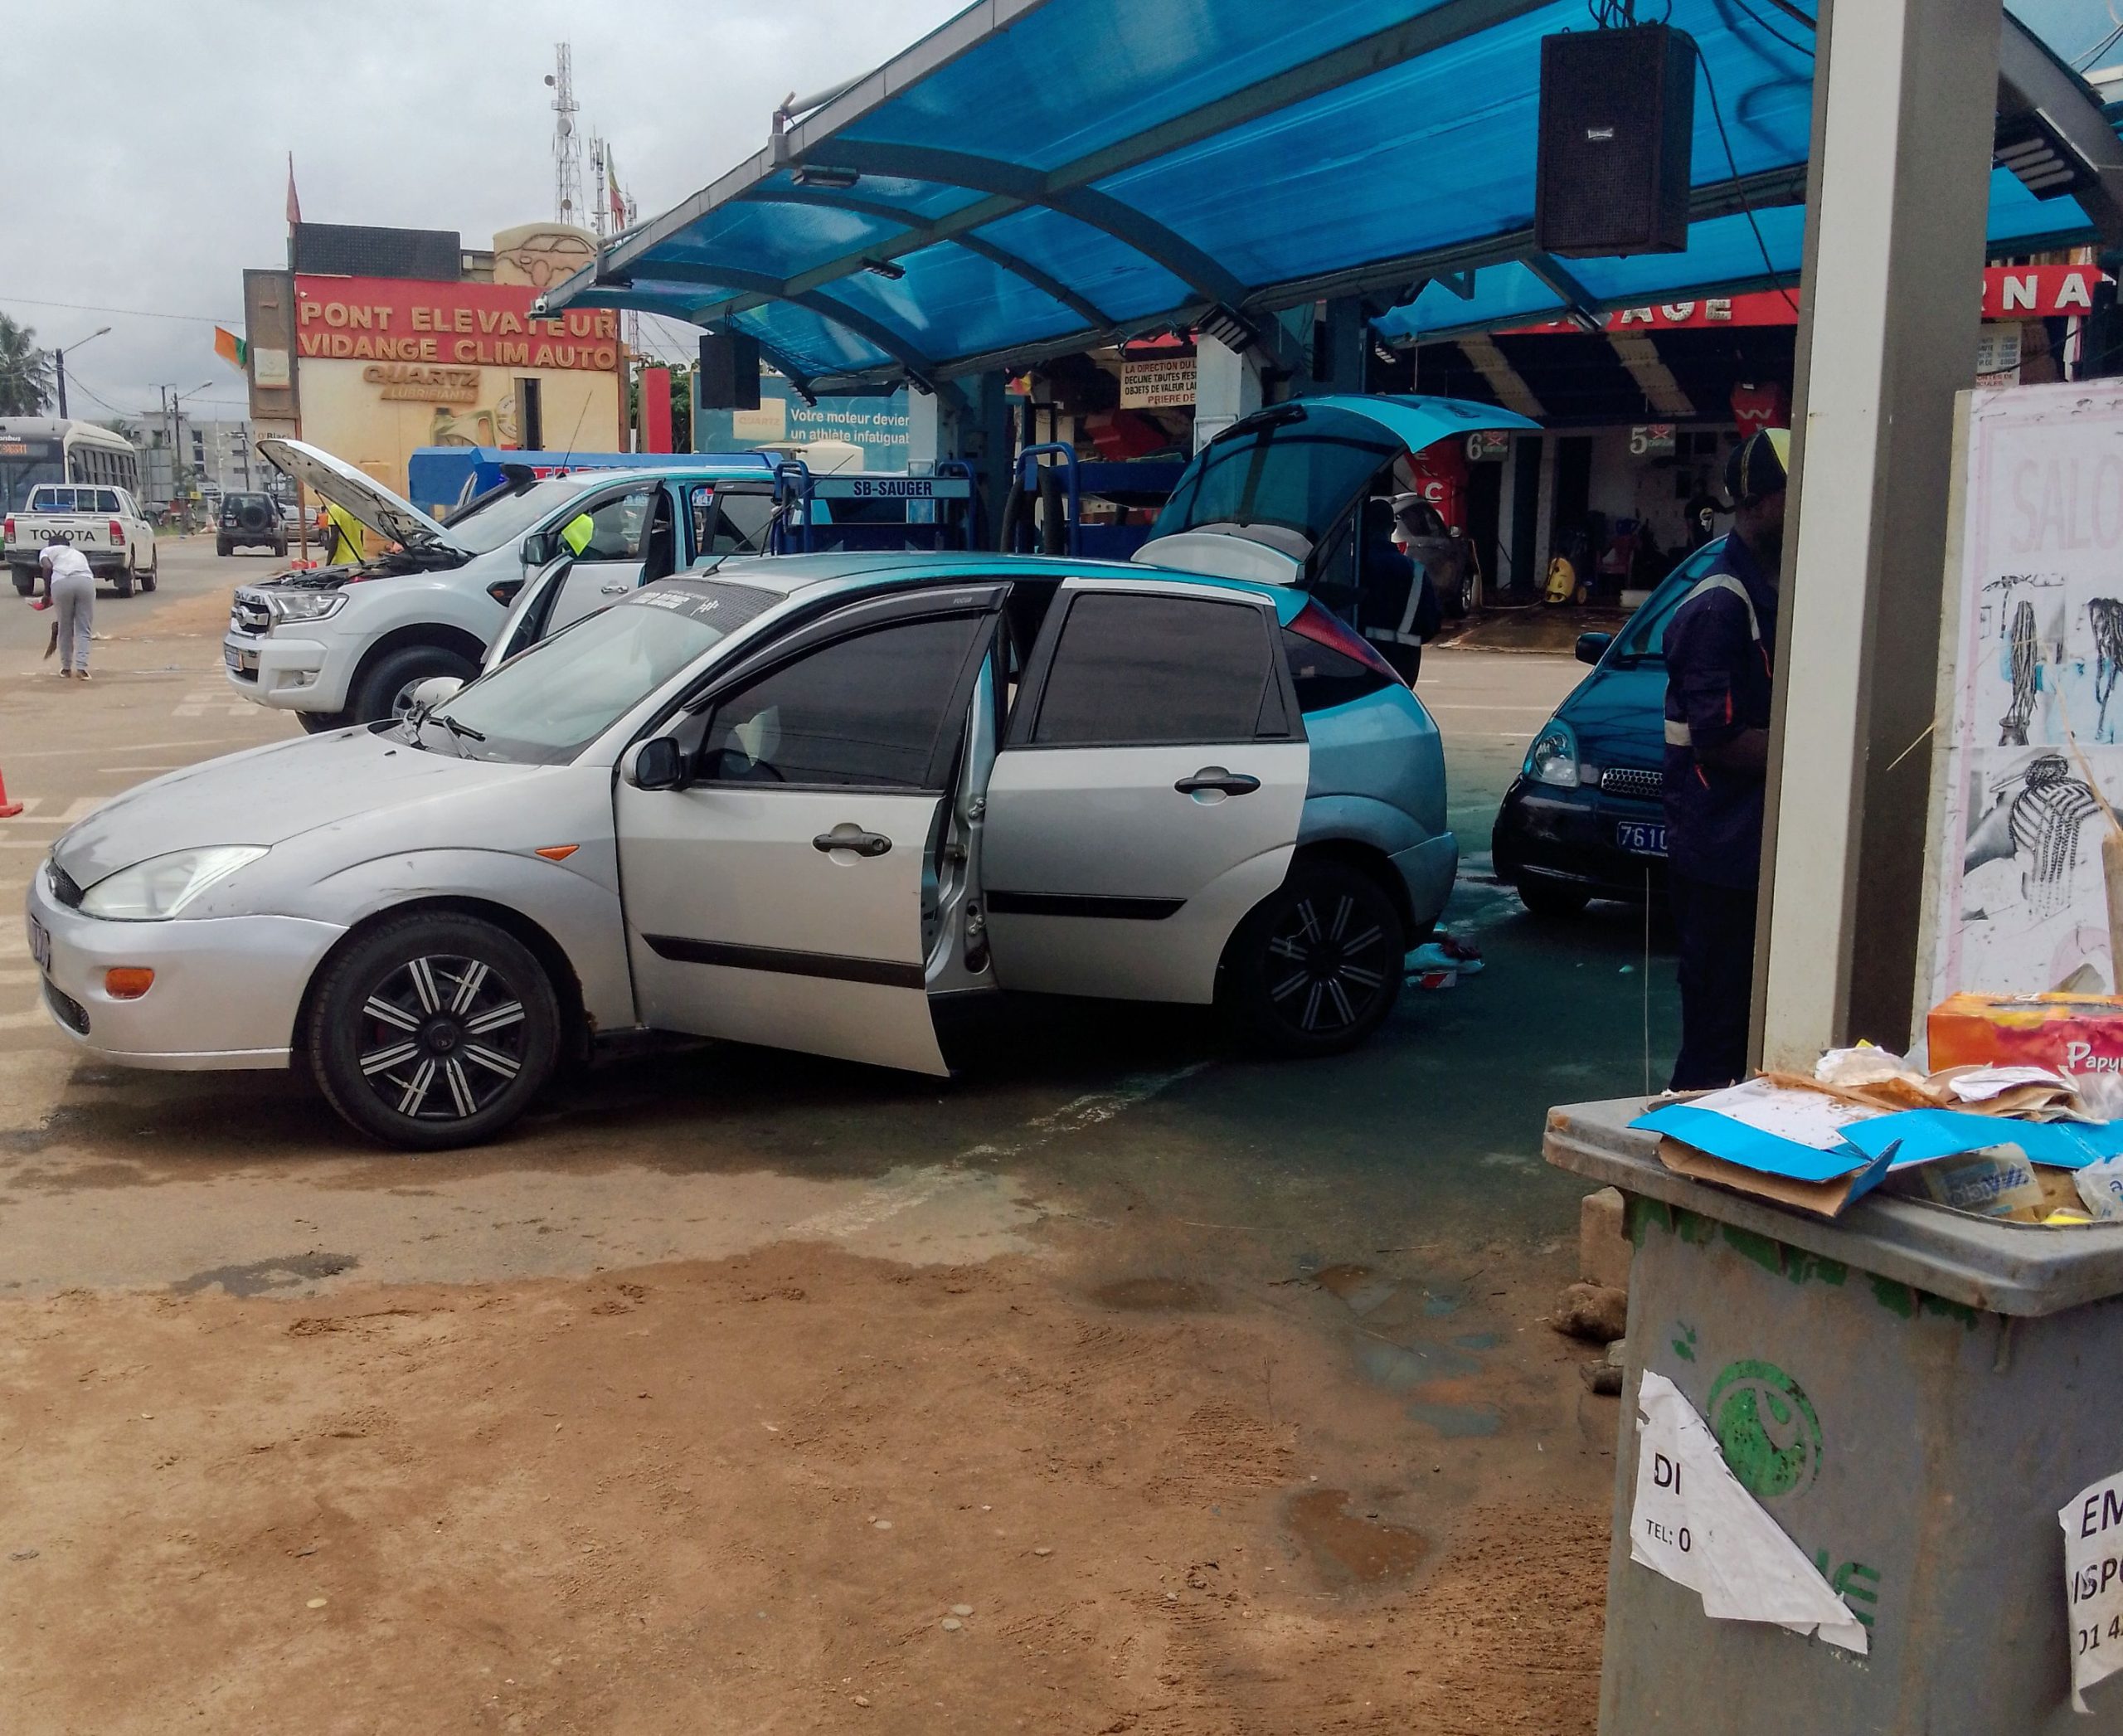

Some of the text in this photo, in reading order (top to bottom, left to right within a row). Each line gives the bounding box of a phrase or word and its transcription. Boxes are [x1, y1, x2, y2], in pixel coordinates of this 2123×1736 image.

[300, 301, 616, 339] PONT ELEVATEUR
[299, 333, 617, 370] VIDANGE CLIM AUTO
[1125, 365, 1135, 373] LA
[1137, 362, 1178, 373] DIRECTION
[1180, 361, 1191, 369] DU
[363, 365, 480, 387] QUARTZ
[1125, 374, 1152, 384] DECLINE
[1154, 372, 1180, 382] TOUTES
[391, 387, 475, 401] LUBRIFIANTS
[1125, 385, 1149, 396] OBJETS
[1151, 384, 1159, 393] DE
[1161, 382, 1184, 392] VALEUR
[1148, 394, 1196, 404] PRIERE DE
[738, 415, 781, 426] QUARTZ
[790, 408, 823, 423] Votre
[827, 411, 869, 425] moteur
[790, 429, 807, 440] un
[809, 428, 850, 442] athlète
[1630, 426, 1648, 455] 5
[1466, 433, 1483, 460] 6
[853, 481, 932, 496] SB-SAUGER
[30, 529, 95, 542] TOYOTA
[2067, 1042, 2123, 1072] Papy
[1654, 1452, 1680, 1495] DI
[1646, 1519, 1673, 1545] TEL:
